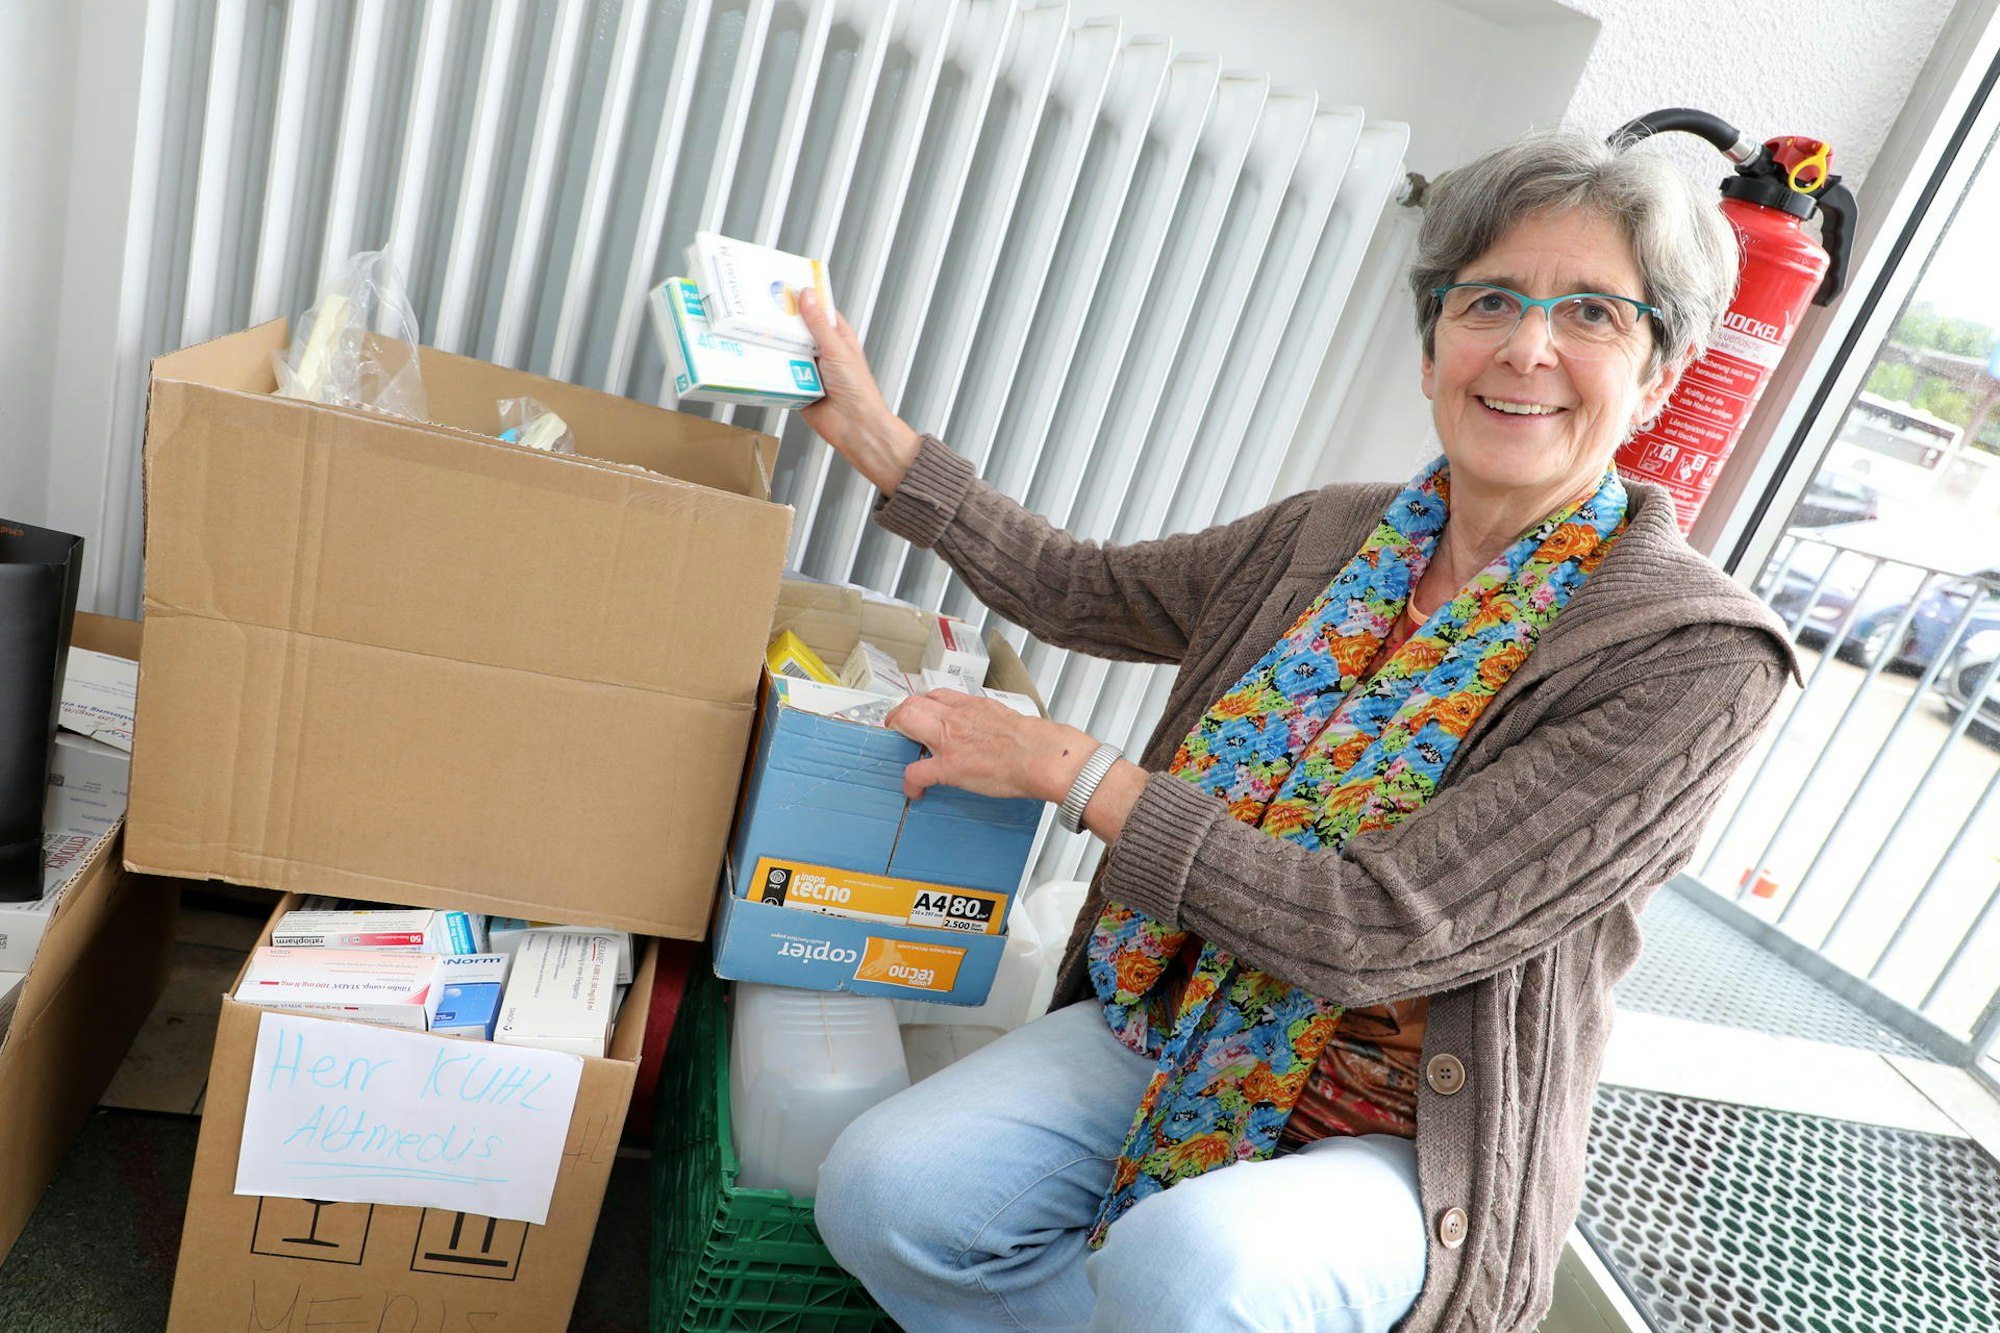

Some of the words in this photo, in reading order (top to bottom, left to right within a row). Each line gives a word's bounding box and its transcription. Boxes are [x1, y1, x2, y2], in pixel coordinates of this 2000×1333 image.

[1722, 311, 1782, 343] JOCKEL
[720, 340, 745, 356] mg
[1664, 447, 1674, 459] A
[791, 874, 851, 904] tecno
[913, 893, 948, 912] A4
[950, 896, 981, 917] 80
[944, 919, 970, 930] 2.500
[276, 936, 324, 946] ratiopharm
[409, 934, 422, 943] 50
[443, 957, 501, 966] Norm
[777, 940, 858, 964] copier
[888, 965, 935, 986] tecno
[267, 1029, 398, 1093] Herr
[283, 1104, 505, 1164] Altmedis
